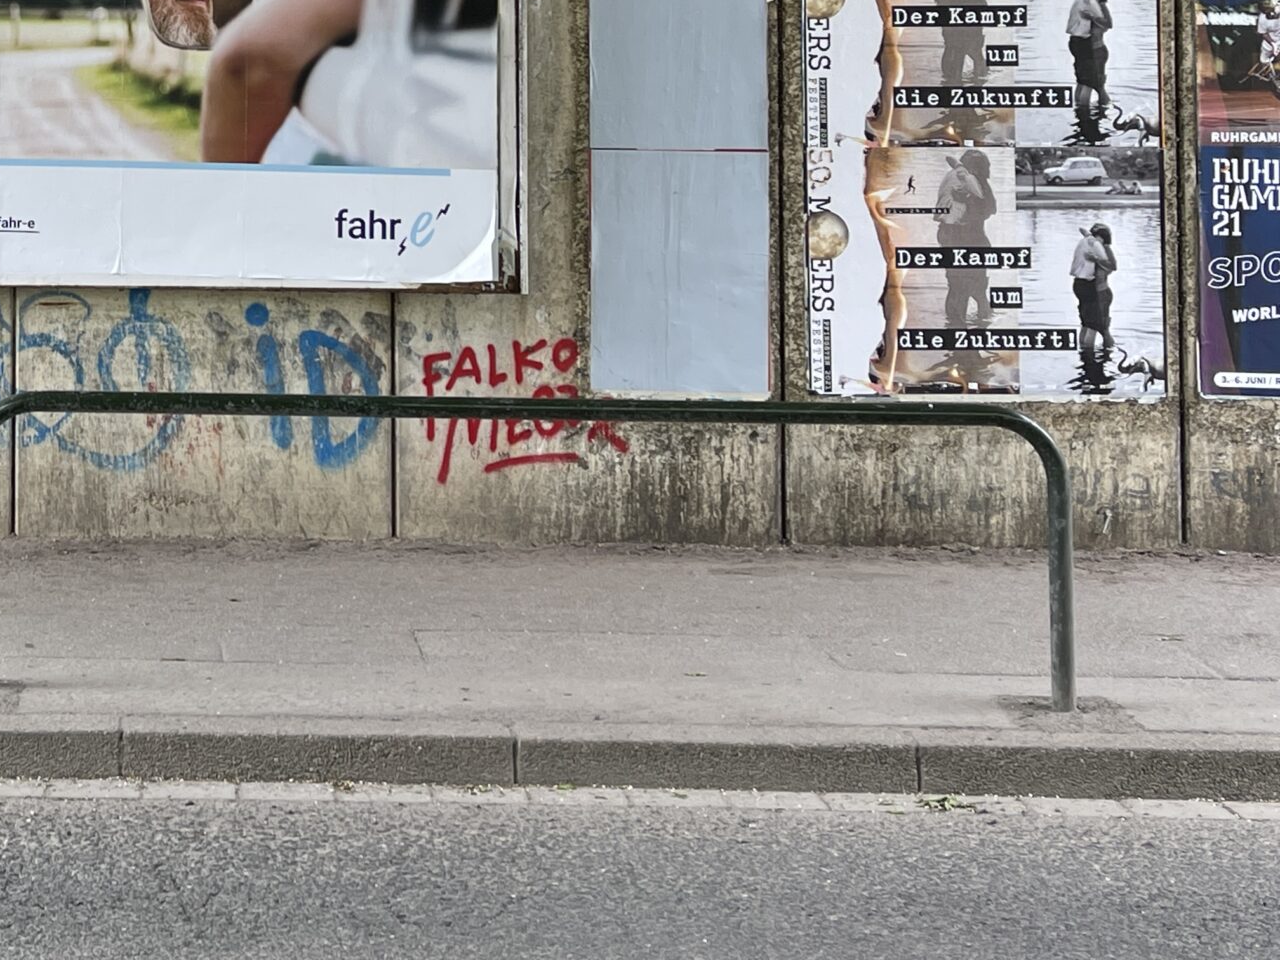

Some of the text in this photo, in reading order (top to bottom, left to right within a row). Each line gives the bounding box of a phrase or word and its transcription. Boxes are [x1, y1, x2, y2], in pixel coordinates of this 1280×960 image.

[893, 7, 1027, 28] Der Kampf
[987, 49, 1019, 63] um
[894, 89, 1072, 106] die Zukunft!
[1210, 131, 1280, 144] RUHRGAM
[1212, 184, 1280, 211] GAM
[1212, 210, 1242, 237] 21
[897, 248, 1030, 269] Der Kampf
[991, 291, 1022, 305] um
[899, 331, 1078, 349] die Zukunft!
[423, 337, 581, 397] FALKO
[1245, 376, 1266, 385] JUNI
